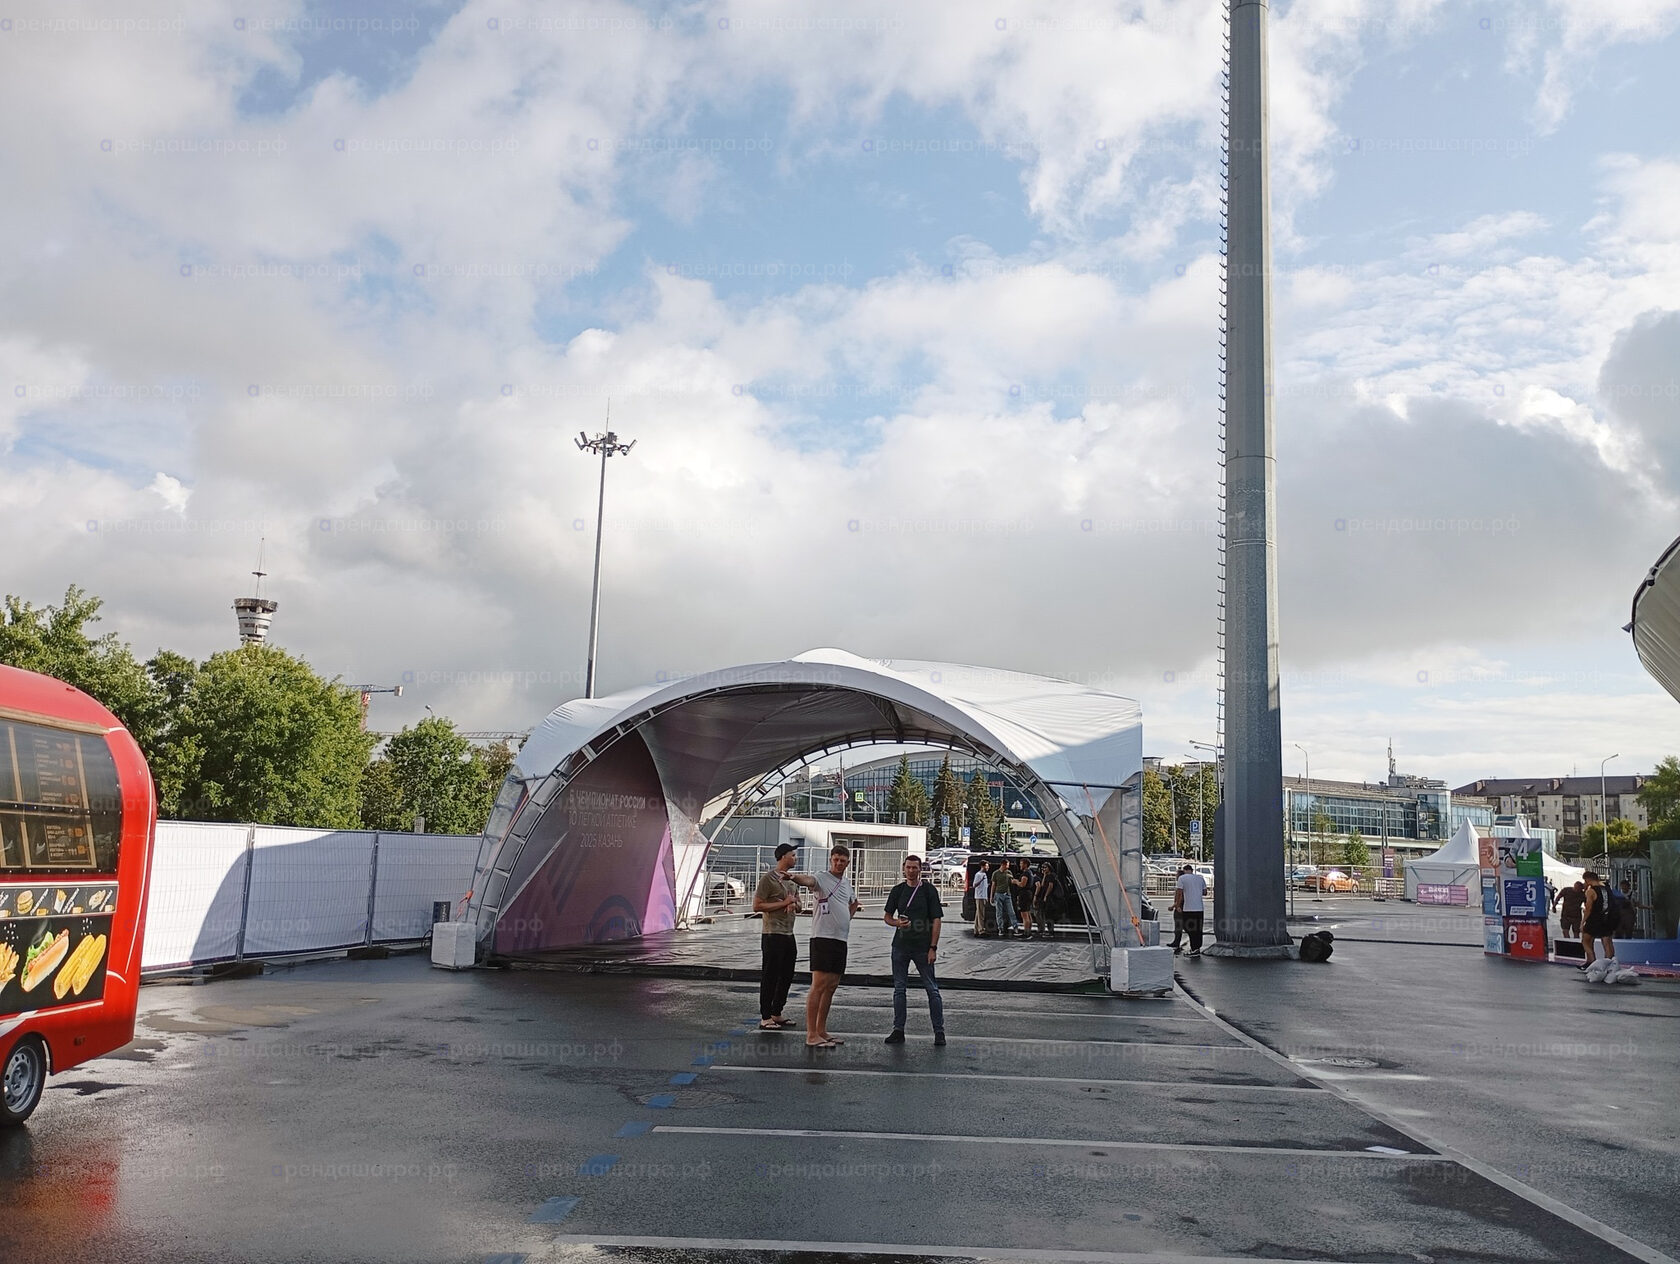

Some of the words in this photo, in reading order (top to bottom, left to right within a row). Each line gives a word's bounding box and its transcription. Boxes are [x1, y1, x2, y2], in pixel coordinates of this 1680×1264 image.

[619, 794, 646, 809] РОССИИ
[1516, 838, 1529, 860] 4
[1526, 880, 1537, 902] 5
[1494, 892, 1500, 913] 2
[1507, 925, 1518, 944] 6
